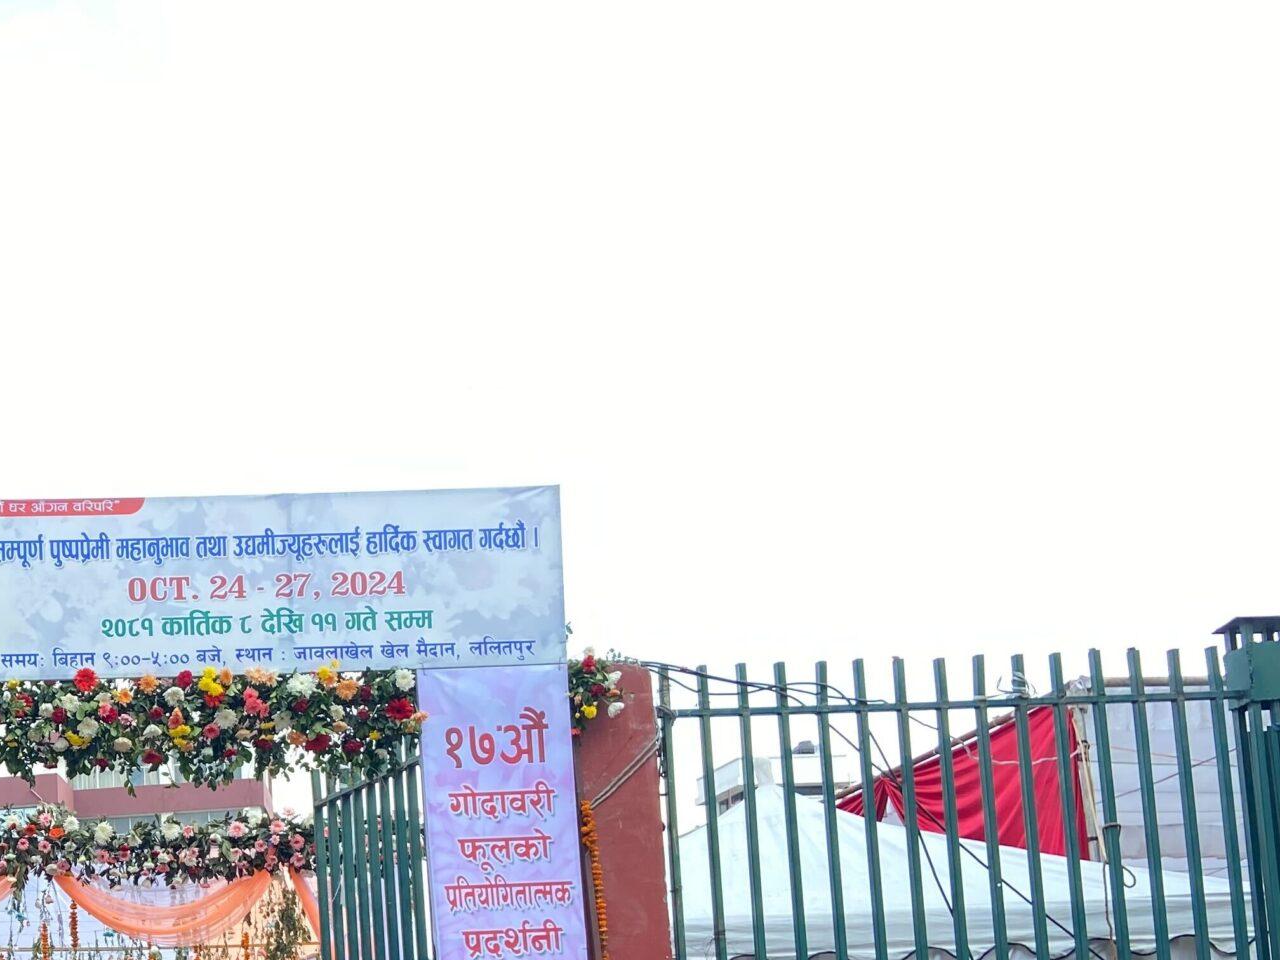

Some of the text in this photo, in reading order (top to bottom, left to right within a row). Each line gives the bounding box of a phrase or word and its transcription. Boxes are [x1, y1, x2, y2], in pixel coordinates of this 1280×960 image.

[115, 536, 190, 565] महानुभाव
[195, 535, 227, 558] तथा
[365, 523, 417, 555] हार्दिक
[422, 528, 474, 553] स्वागत
[128, 576, 198, 601] OCT.
[209, 574, 247, 600] 24
[275, 573, 320, 601] 27,
[331, 571, 406, 597] 2024
[101, 606, 434, 638] २०८१ कार्तिक ८ देखि ११ गते सम्म
[52, 647, 96, 668] बिहान
[196, 645, 226, 666] बजे,
[235, 647, 273, 662] स्थान
[293, 641, 373, 660] जावलाखेल
[380, 640, 409, 658] खेल
[415, 637, 460, 660] मैदान,
[469, 635, 536, 661] ललितपुर
[448, 781, 556, 819] गोदावरी
[457, 828, 552, 870] फूलको
[444, 875, 573, 912] प्रतियोगितात्मक
[462, 918, 563, 958] प्रदर्शनी
